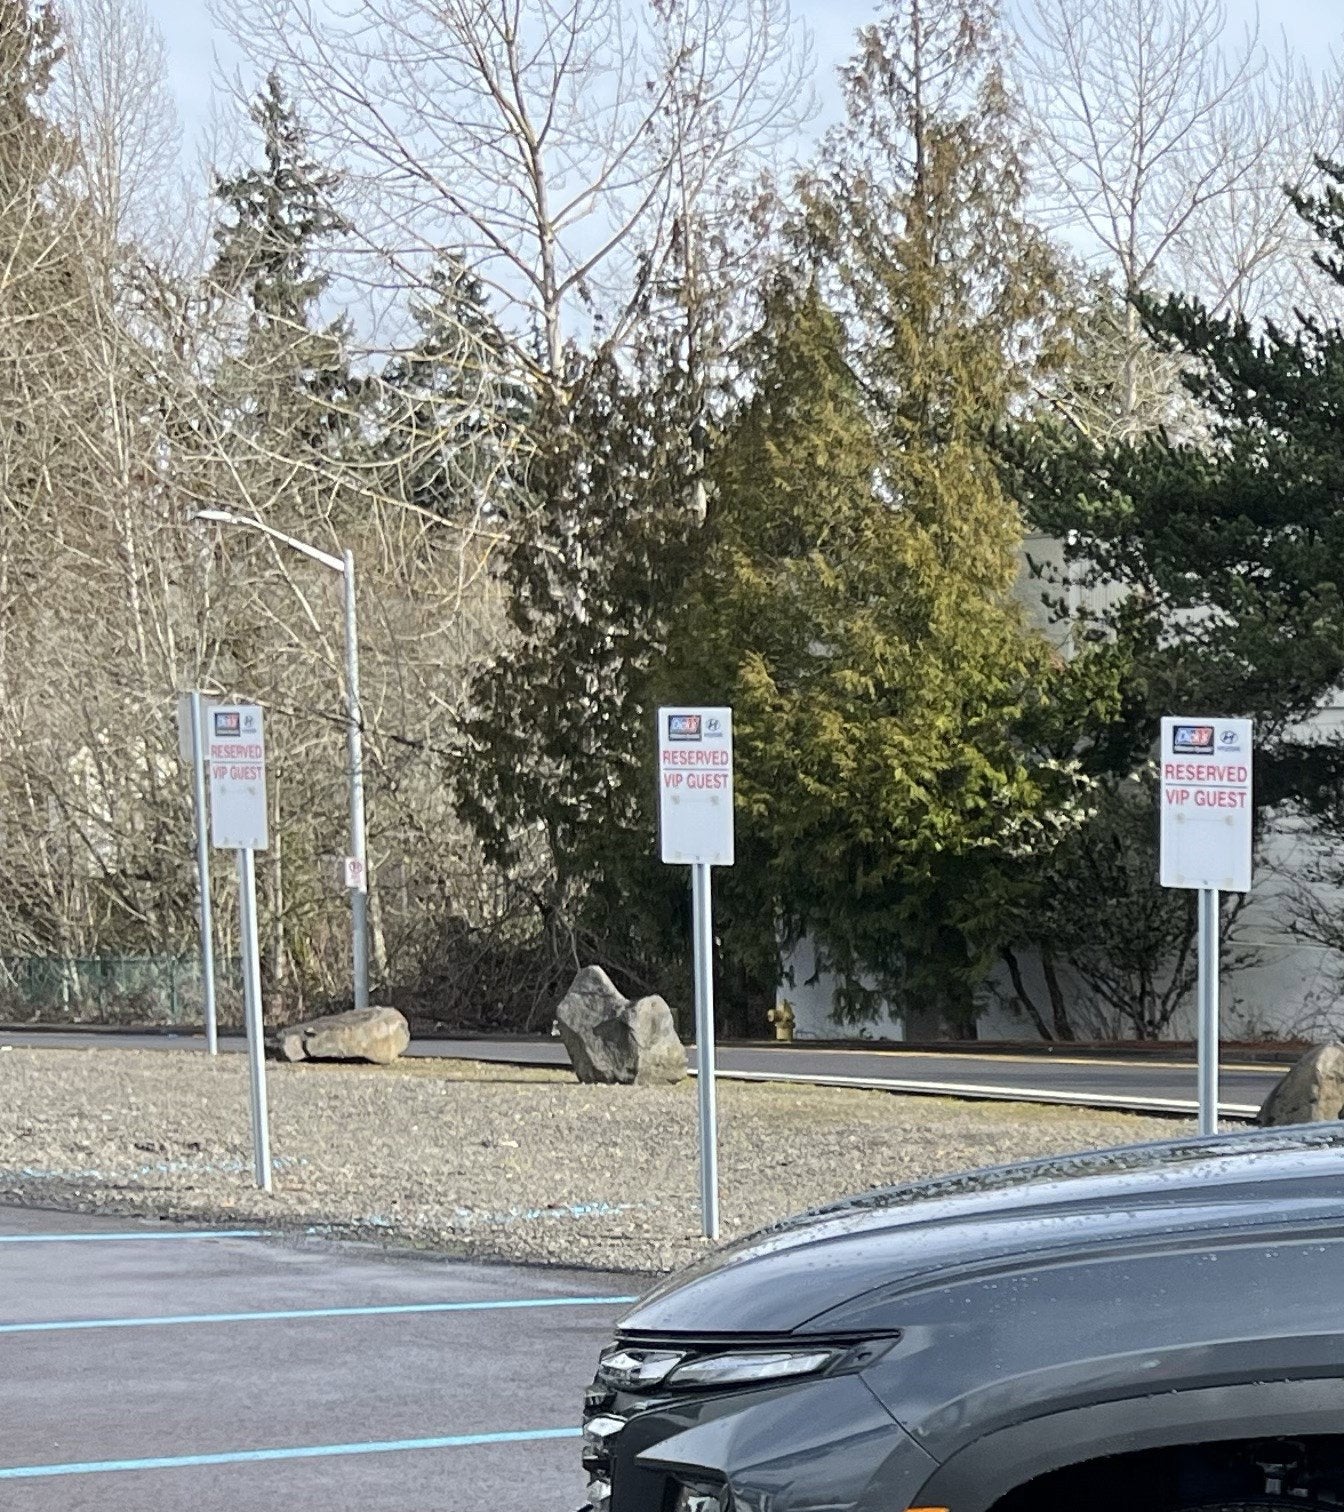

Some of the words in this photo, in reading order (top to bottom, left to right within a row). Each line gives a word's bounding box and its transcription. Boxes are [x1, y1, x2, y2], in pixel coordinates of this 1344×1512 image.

[211, 744, 262, 758] RESERVED
[663, 750, 729, 765] RESERVED
[664, 773, 683, 788] VIP
[687, 773, 728, 789] GUEST
[1165, 764, 1248, 782] RESERVED
[1166, 789, 1190, 805] VIP
[1195, 790, 1247, 808] GUEST
